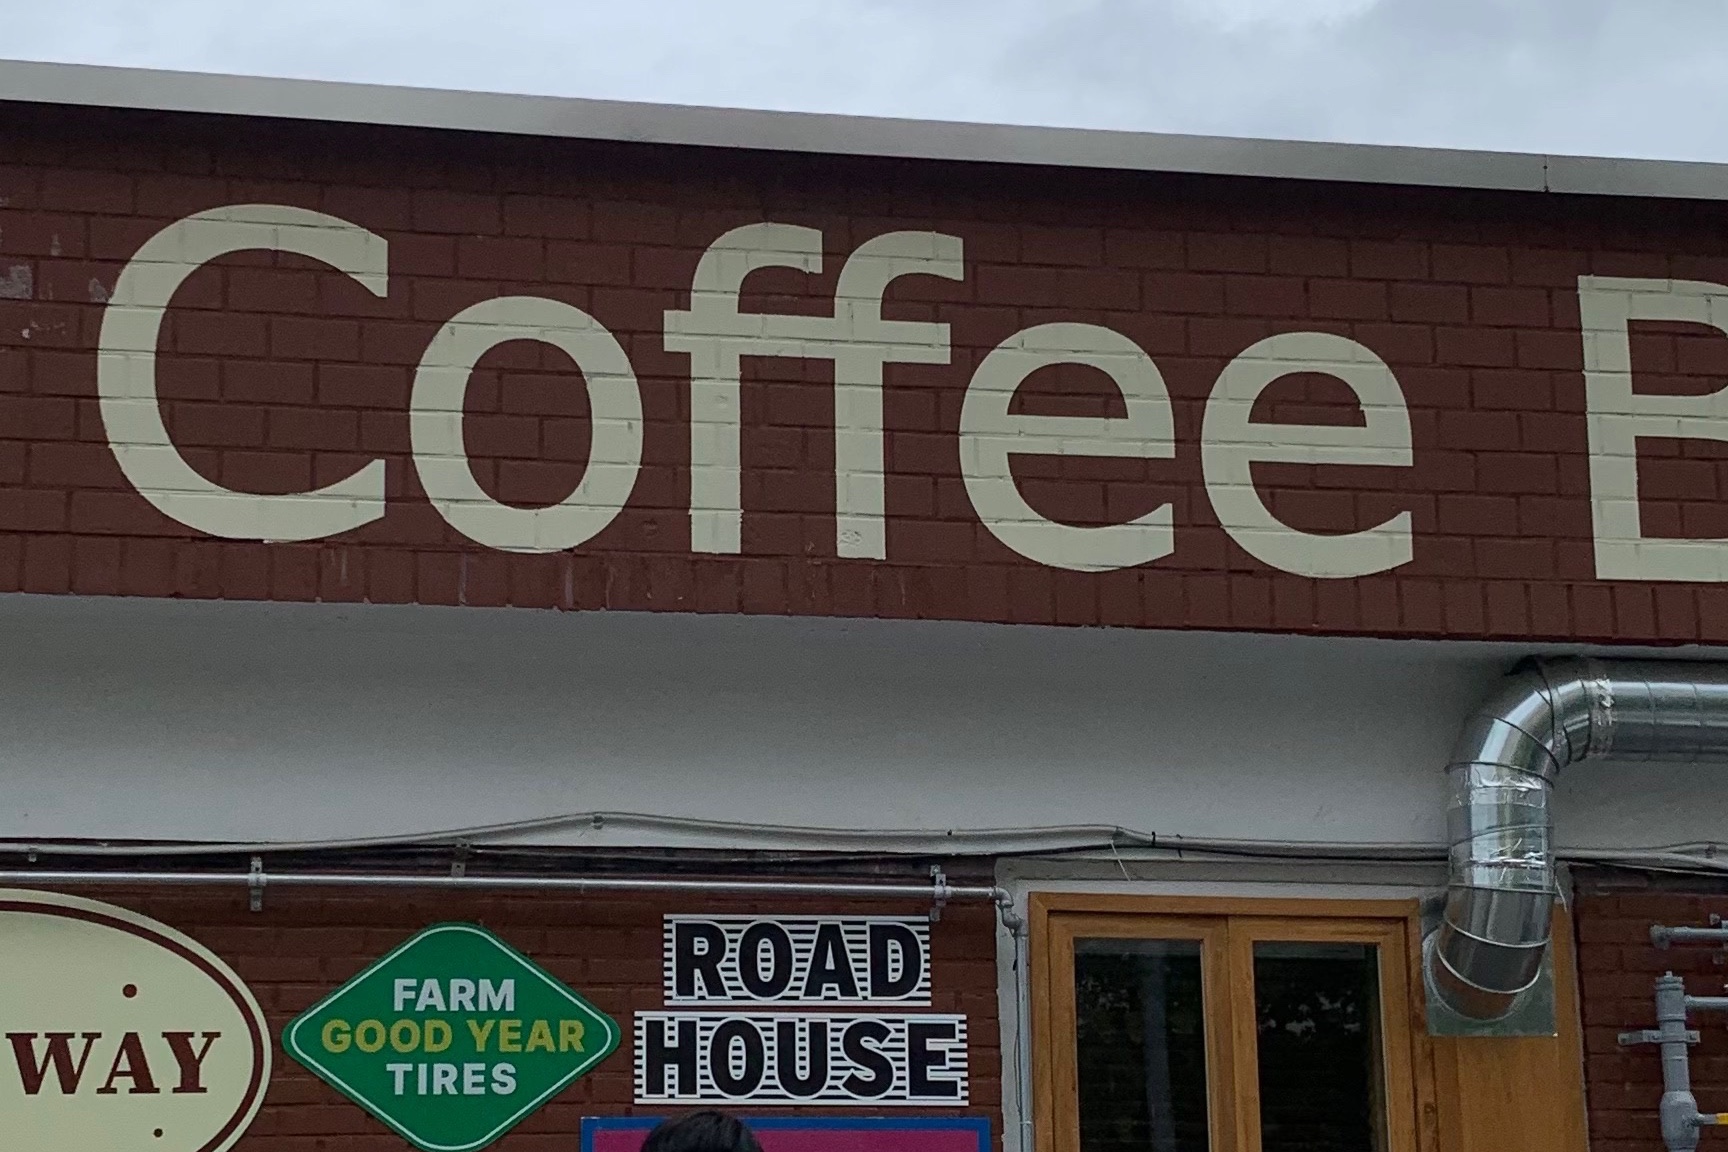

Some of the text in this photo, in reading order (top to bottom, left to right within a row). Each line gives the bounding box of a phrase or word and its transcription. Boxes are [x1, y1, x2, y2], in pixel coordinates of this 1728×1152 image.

[97, 203, 1413, 578] Coffee
[674, 920, 922, 998] ROAD
[393, 978, 515, 1011] FARM
[5, 1031, 222, 1095] WAY
[321, 1020, 585, 1053] GOOD YEAR
[644, 1018, 961, 1098] HOUSE
[386, 1063, 517, 1095] TIRES
